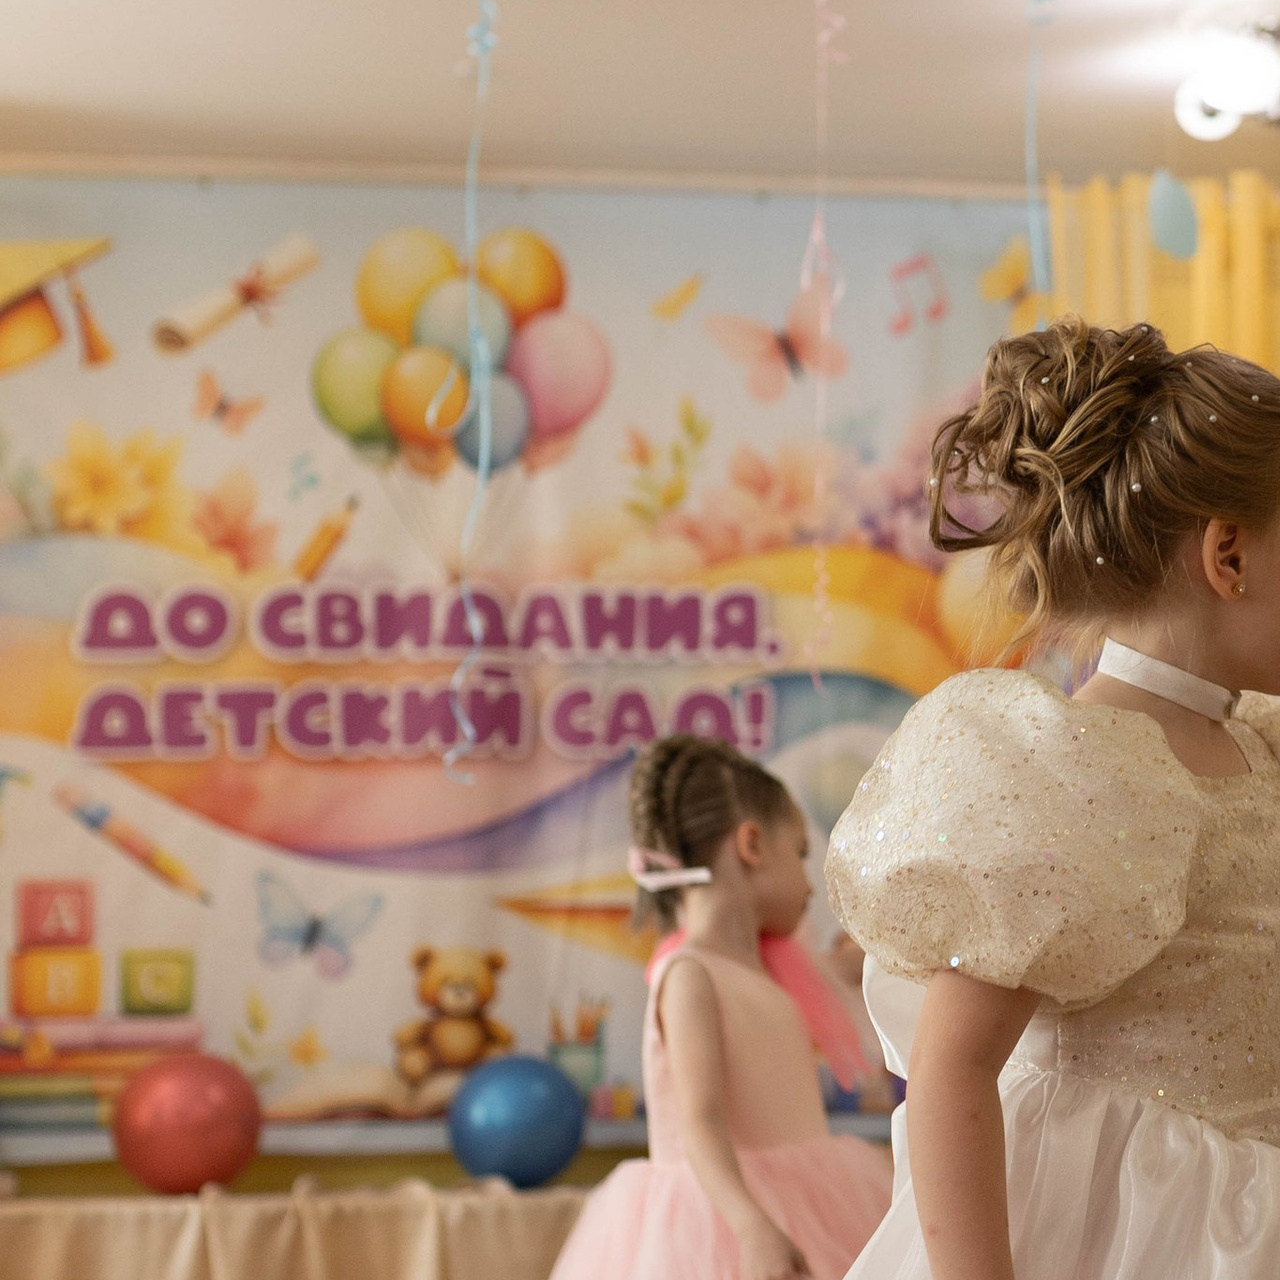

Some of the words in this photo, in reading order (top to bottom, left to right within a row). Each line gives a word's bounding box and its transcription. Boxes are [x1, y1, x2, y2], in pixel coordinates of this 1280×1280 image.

[84, 593, 229, 650] ДО
[79, 667, 522, 748] ДЕТСКИЙ
[552, 689, 765, 748] САД!
[39, 893, 80, 938] A
